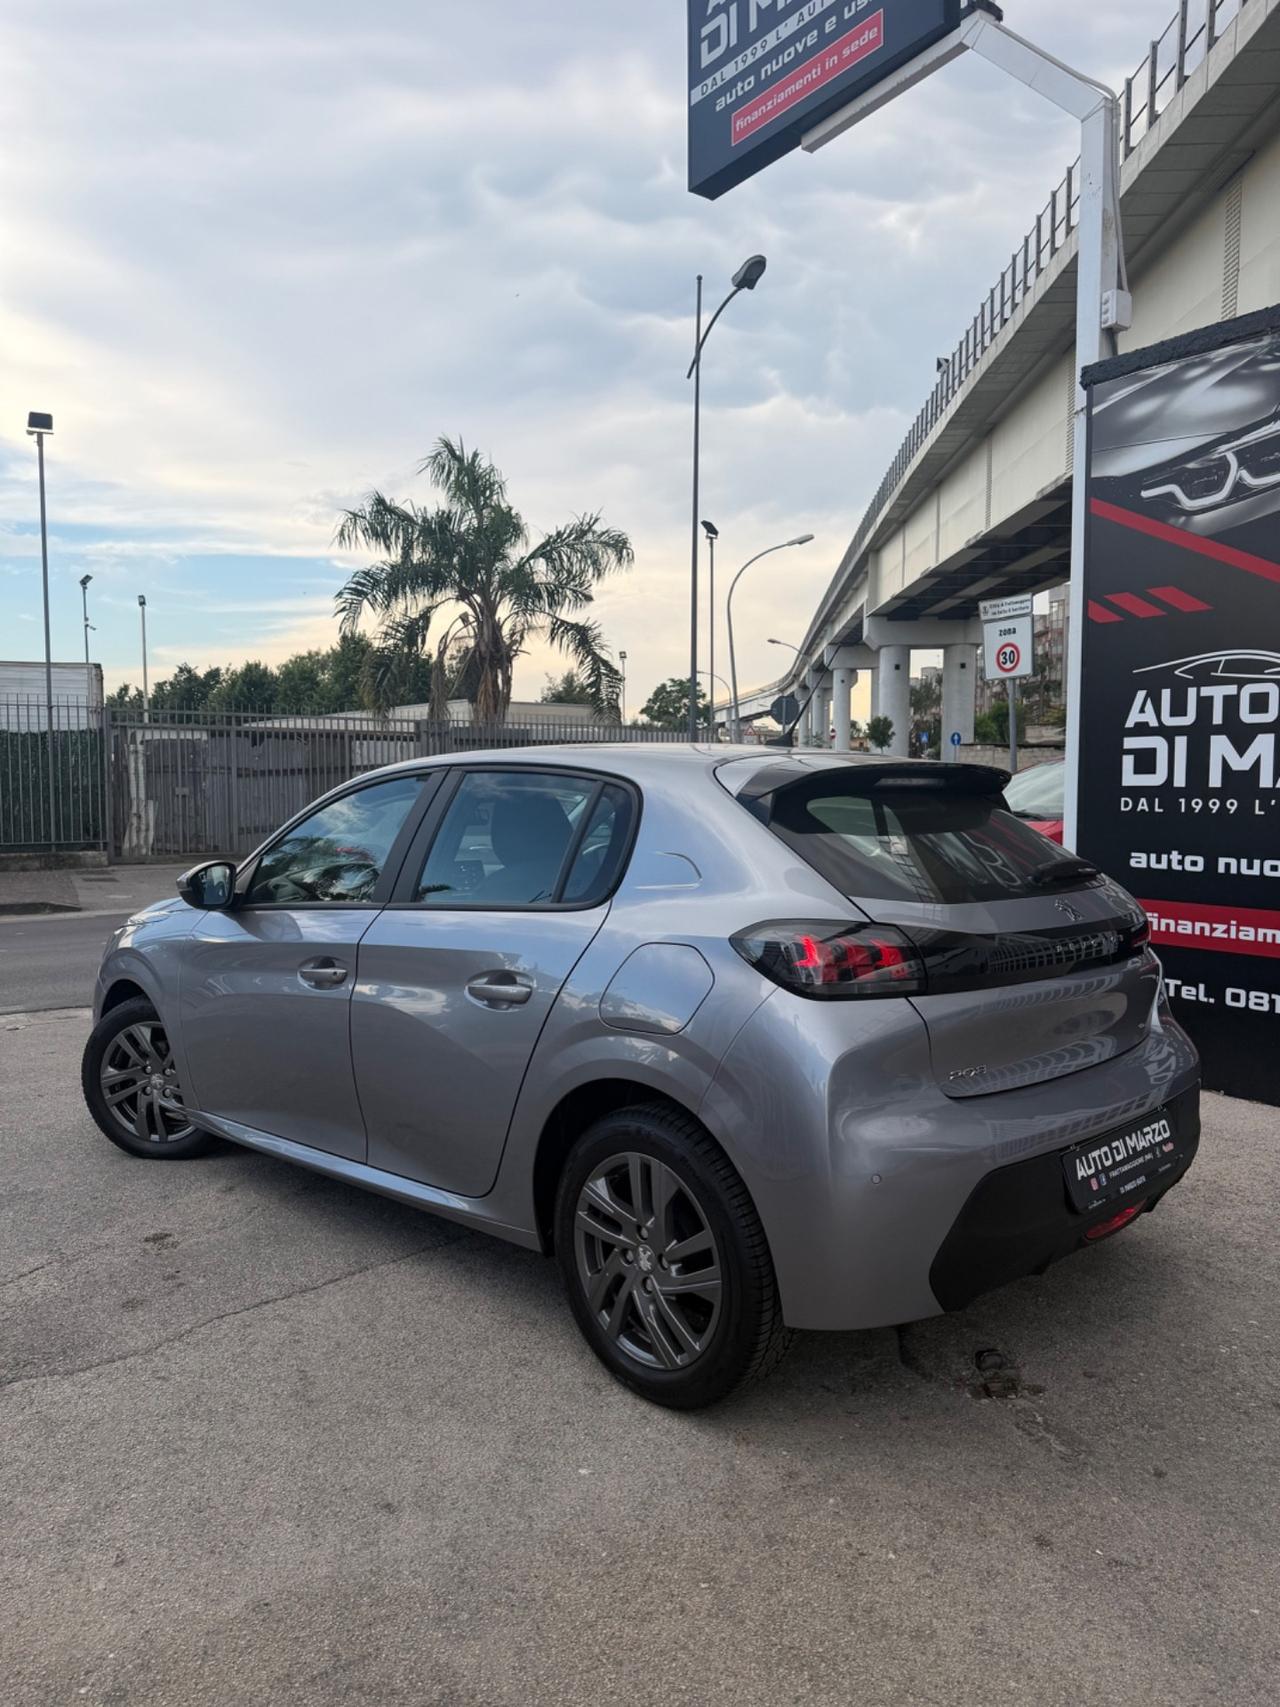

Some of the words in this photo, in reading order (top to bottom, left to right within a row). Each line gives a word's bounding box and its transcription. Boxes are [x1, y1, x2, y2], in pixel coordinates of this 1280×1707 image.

[701, 2, 738, 69] DI
[716, 75, 755, 112] auto
[761, 29, 818, 80] nuove
[824, 15, 838, 34] e
[843, 0, 872, 20] us
[701, 71, 727, 96] DAL
[733, 39, 769, 71] 1999
[735, 66, 822, 132] finanziamenti
[825, 53, 838, 69] in
[842, 26, 878, 58] sede
[1000, 649, 1016, 665] 30
[1124, 682, 1280, 728] AUTO
[1121, 735, 1188, 787] DI
[1208, 733, 1280, 788] M
[1120, 797, 1165, 813] DAL
[1178, 798, 1239, 814] 1999
[1129, 850, 1205, 872] auto
[1217, 857, 1280, 877] nuo
[1164, 978, 1215, 1003] Tel.
[1225, 987, 1280, 1014] 081
[1075, 1146, 1113, 1181] AUTO
[1111, 1138, 1127, 1162] DI
[1125, 1119, 1171, 1155] MARZO
